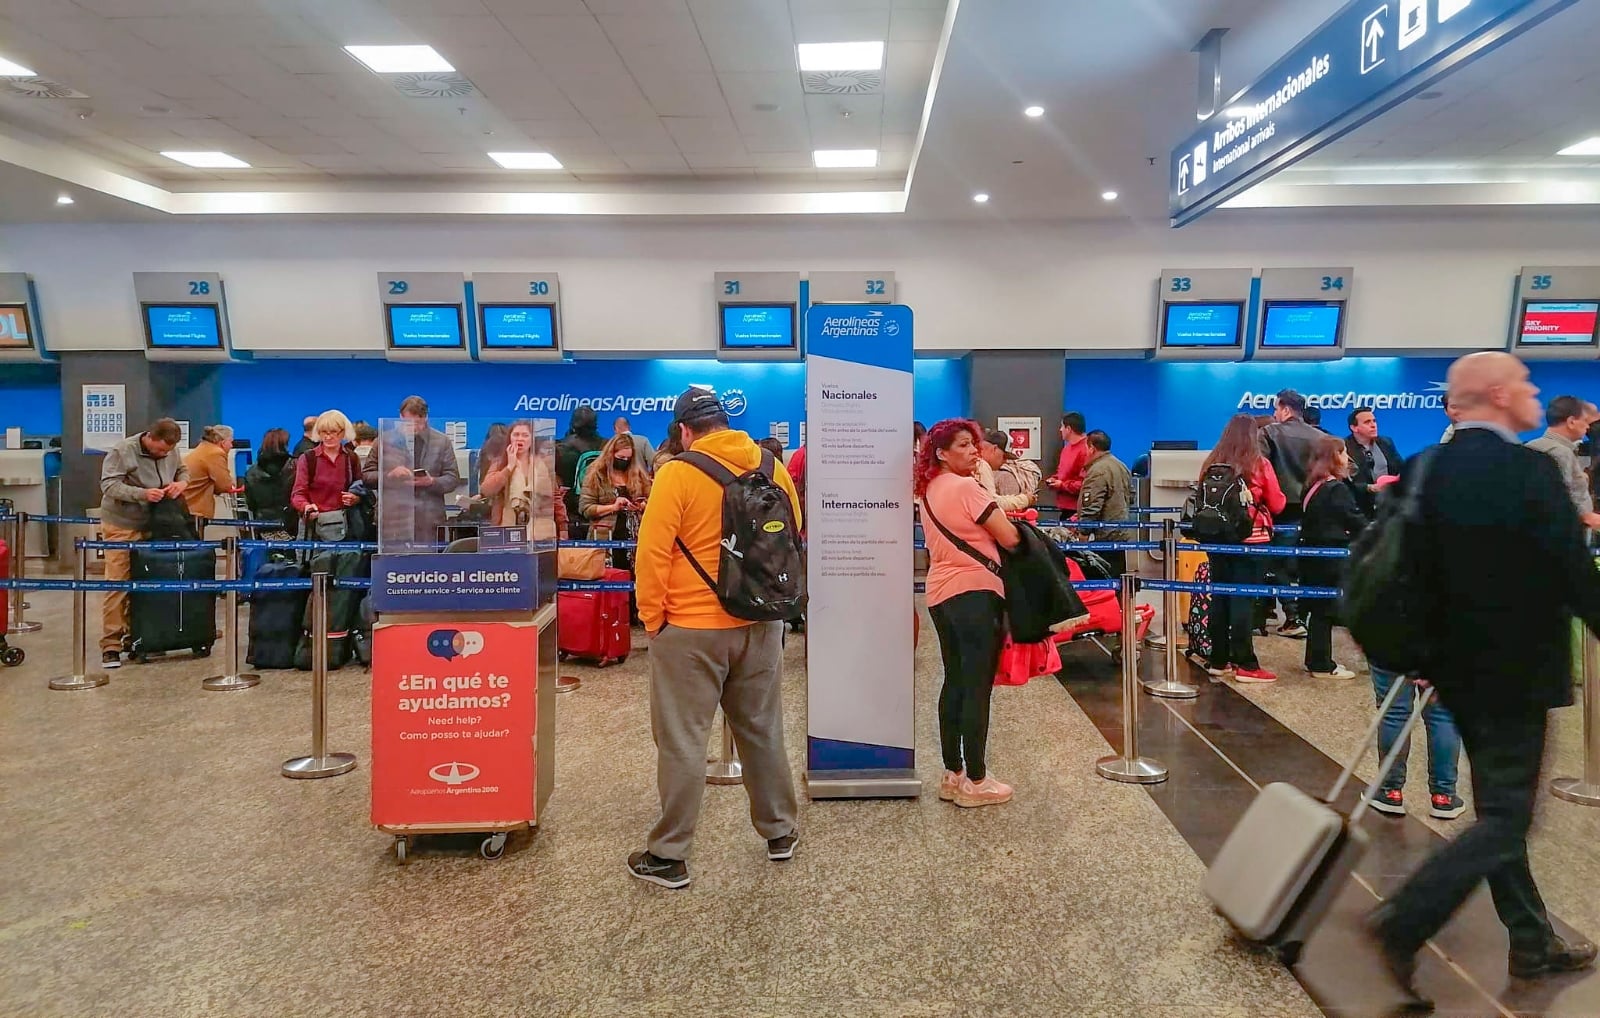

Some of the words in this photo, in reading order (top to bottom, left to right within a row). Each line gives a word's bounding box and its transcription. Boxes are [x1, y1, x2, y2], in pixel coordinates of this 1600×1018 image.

[1213, 117, 1246, 153] Arribos
[1246, 53, 1330, 130] Internacionales
[1213, 135, 1251, 174] International
[1251, 120, 1276, 149] arrivals
[188, 281, 210, 295] 28
[388, 280, 408, 295] 29
[529, 281, 549, 295] 30
[724, 280, 740, 295] 31
[865, 280, 885, 295] 32
[1171, 277, 1192, 292] 33
[1320, 276, 1344, 291] 34
[1531, 275, 1552, 290] 35
[823, 316, 881, 327] Aerolíneas
[821, 326, 879, 338] Argentinas
[821, 390, 878, 400] Nacionales
[1237, 391, 1445, 412] AereasArgentinas
[514, 394, 678, 415] AerolíneasArgenti
[821, 499, 900, 509] Internacionales
[386, 571, 448, 584] Servicio
[451, 571, 465, 583] al
[468, 570, 519, 583] cliente
[386, 587, 423, 595] Customer
[424, 587, 450, 595] service
[456, 587, 484, 595] Serviço
[496, 586, 521, 594] cliente
[398, 674, 437, 690] ¿En
[442, 672, 482, 692] qué
[488, 673, 509, 689] te
[398, 692, 511, 712] ayudamos?
[428, 716, 454, 725] Need
[456, 715, 482, 725] help?
[399, 731, 429, 740] Como
[431, 731, 460, 741] posso
[462, 730, 472, 738] te
[474, 729, 510, 739] ajudar?
